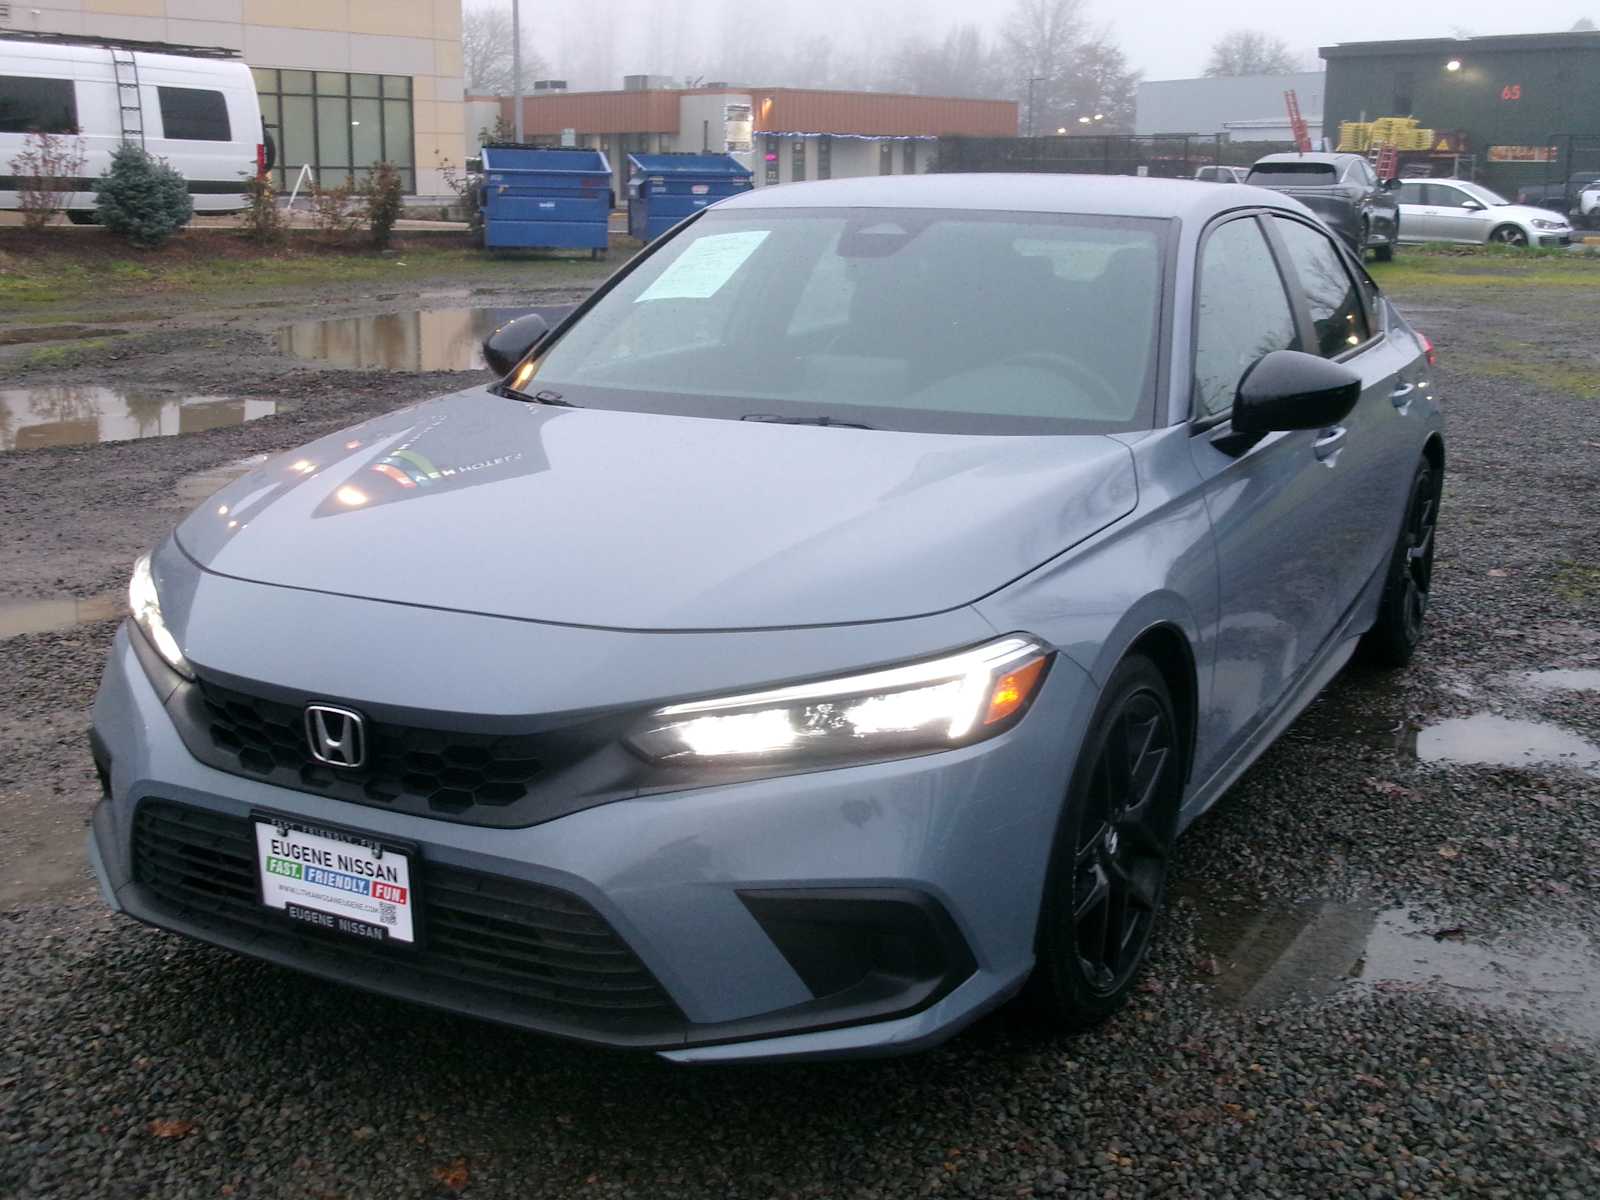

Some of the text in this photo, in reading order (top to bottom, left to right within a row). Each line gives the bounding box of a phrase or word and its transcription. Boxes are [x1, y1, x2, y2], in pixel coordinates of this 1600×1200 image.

[1503, 84, 1520, 101] 65
[271, 839, 398, 883] EUGENE NISSAN
[269, 858, 300, 878] FAST.
[308, 869, 369, 895] FRIENDLY.
[376, 884, 405, 903] FUN.
[289, 907, 383, 940] EUGENE NISSAN
